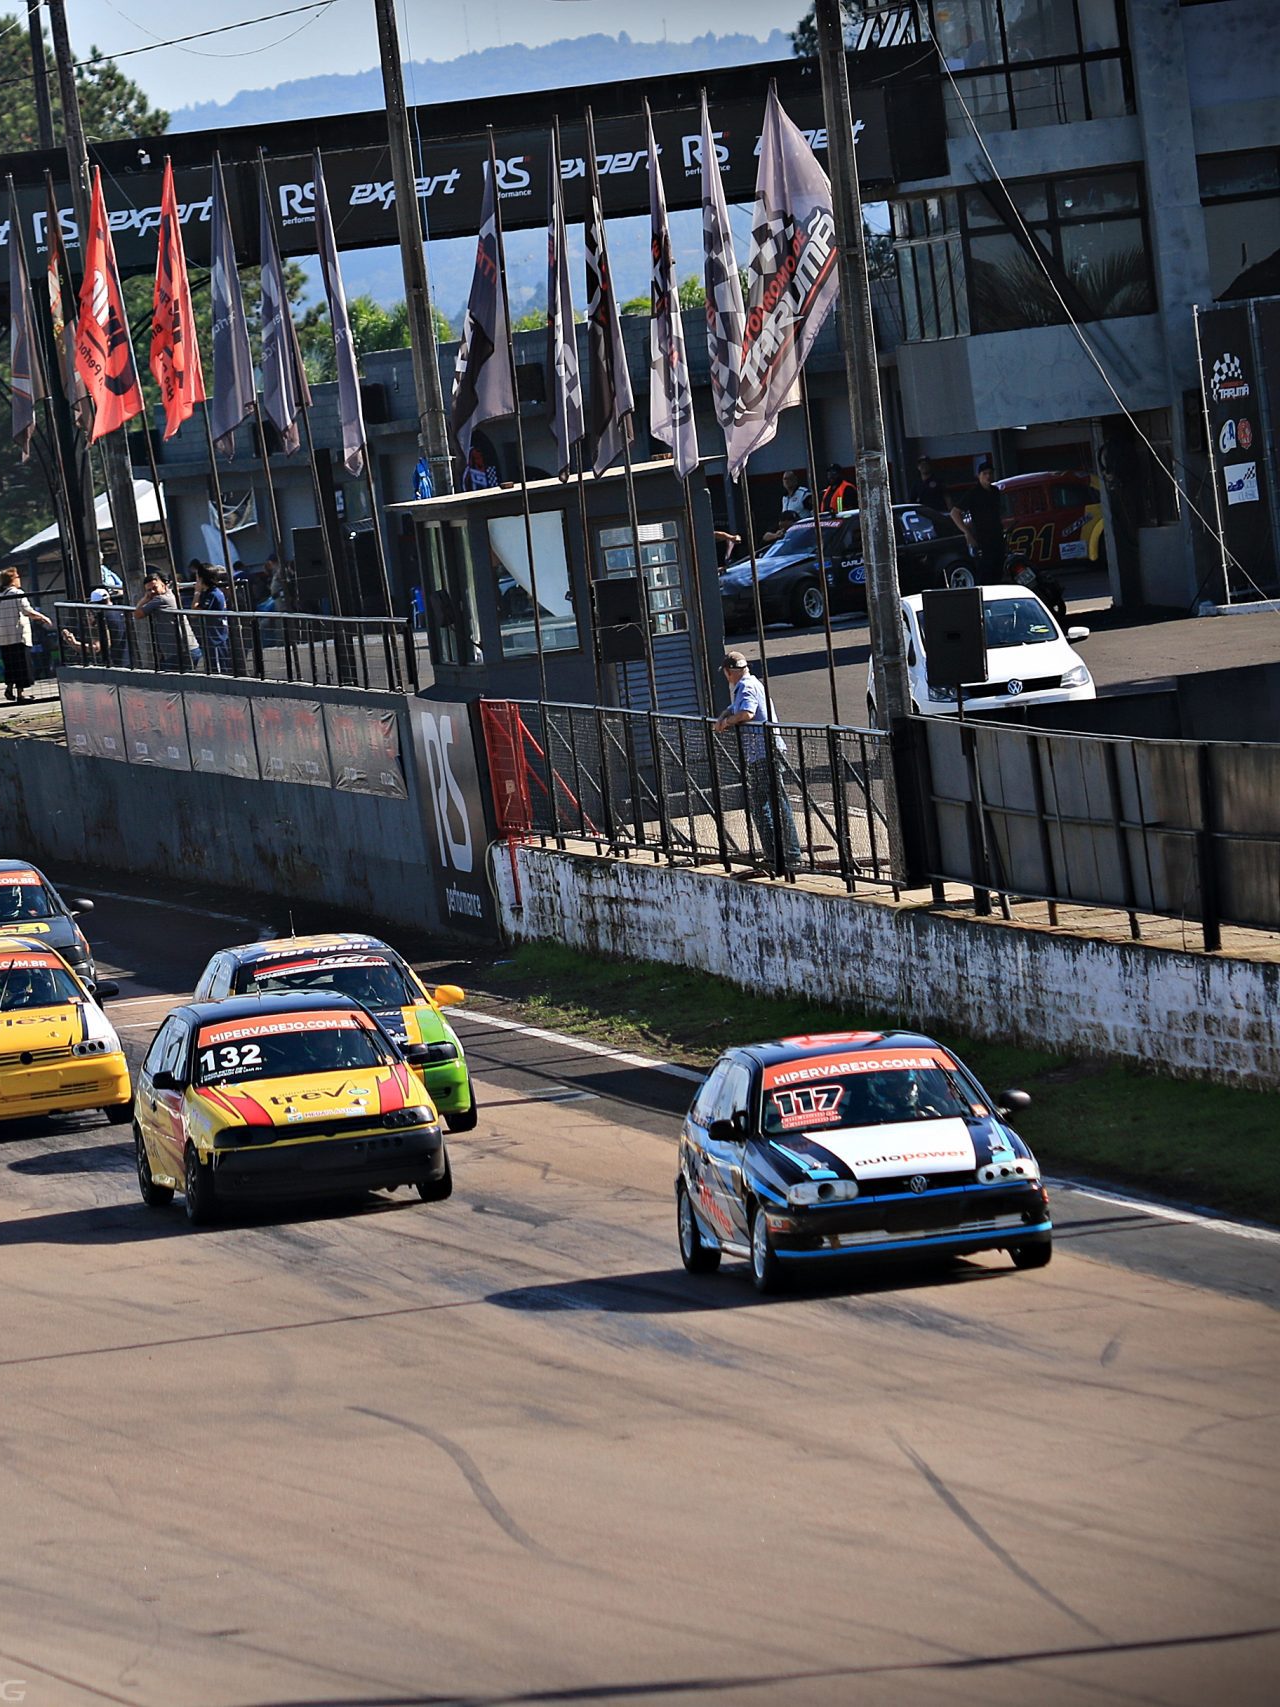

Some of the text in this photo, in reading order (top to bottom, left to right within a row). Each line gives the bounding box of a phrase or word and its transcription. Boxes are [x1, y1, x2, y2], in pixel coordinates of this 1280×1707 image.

[421, 711, 473, 873] RS
[210, 1019, 360, 1043] HIPERVAREJO.COM.BR
[200, 1044, 262, 1072] 132
[774, 1084, 844, 1117] 117
[855, 1150, 969, 1167] autopower
